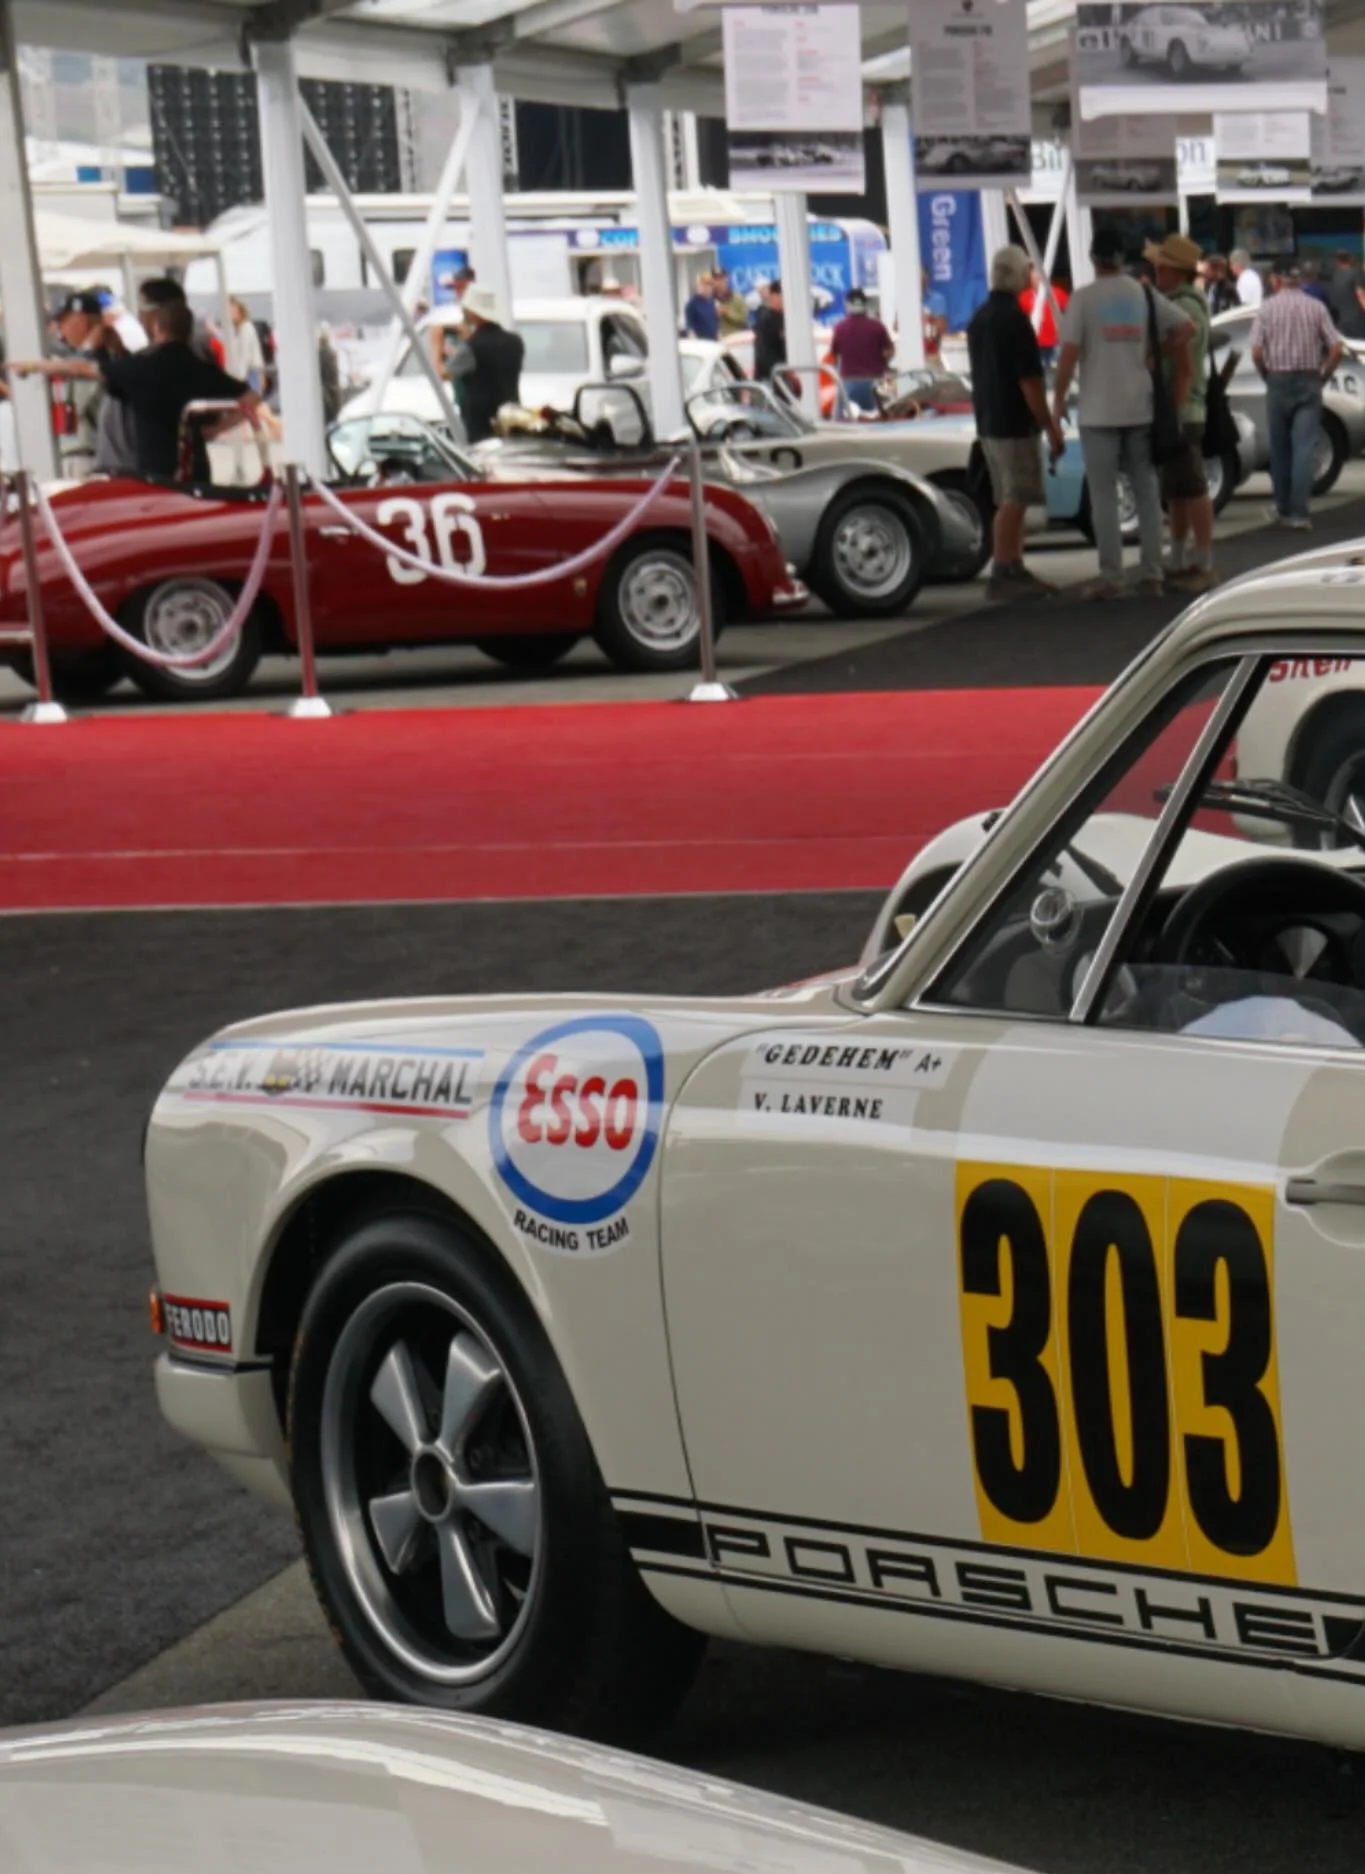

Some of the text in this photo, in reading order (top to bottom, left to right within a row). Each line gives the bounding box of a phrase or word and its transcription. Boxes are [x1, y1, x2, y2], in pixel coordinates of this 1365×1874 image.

[931, 195, 957, 281] Green
[376, 491, 487, 585] 36
[329, 1056, 474, 1105] MARCHAL
[754, 1093, 883, 1119] V. LAVERNE
[514, 1209, 630, 1251] RACING TEAM
[164, 1305, 231, 1345] FERODO
[961, 1177, 1281, 1557] 303
[706, 1523, 1320, 1655] PORSCHE
